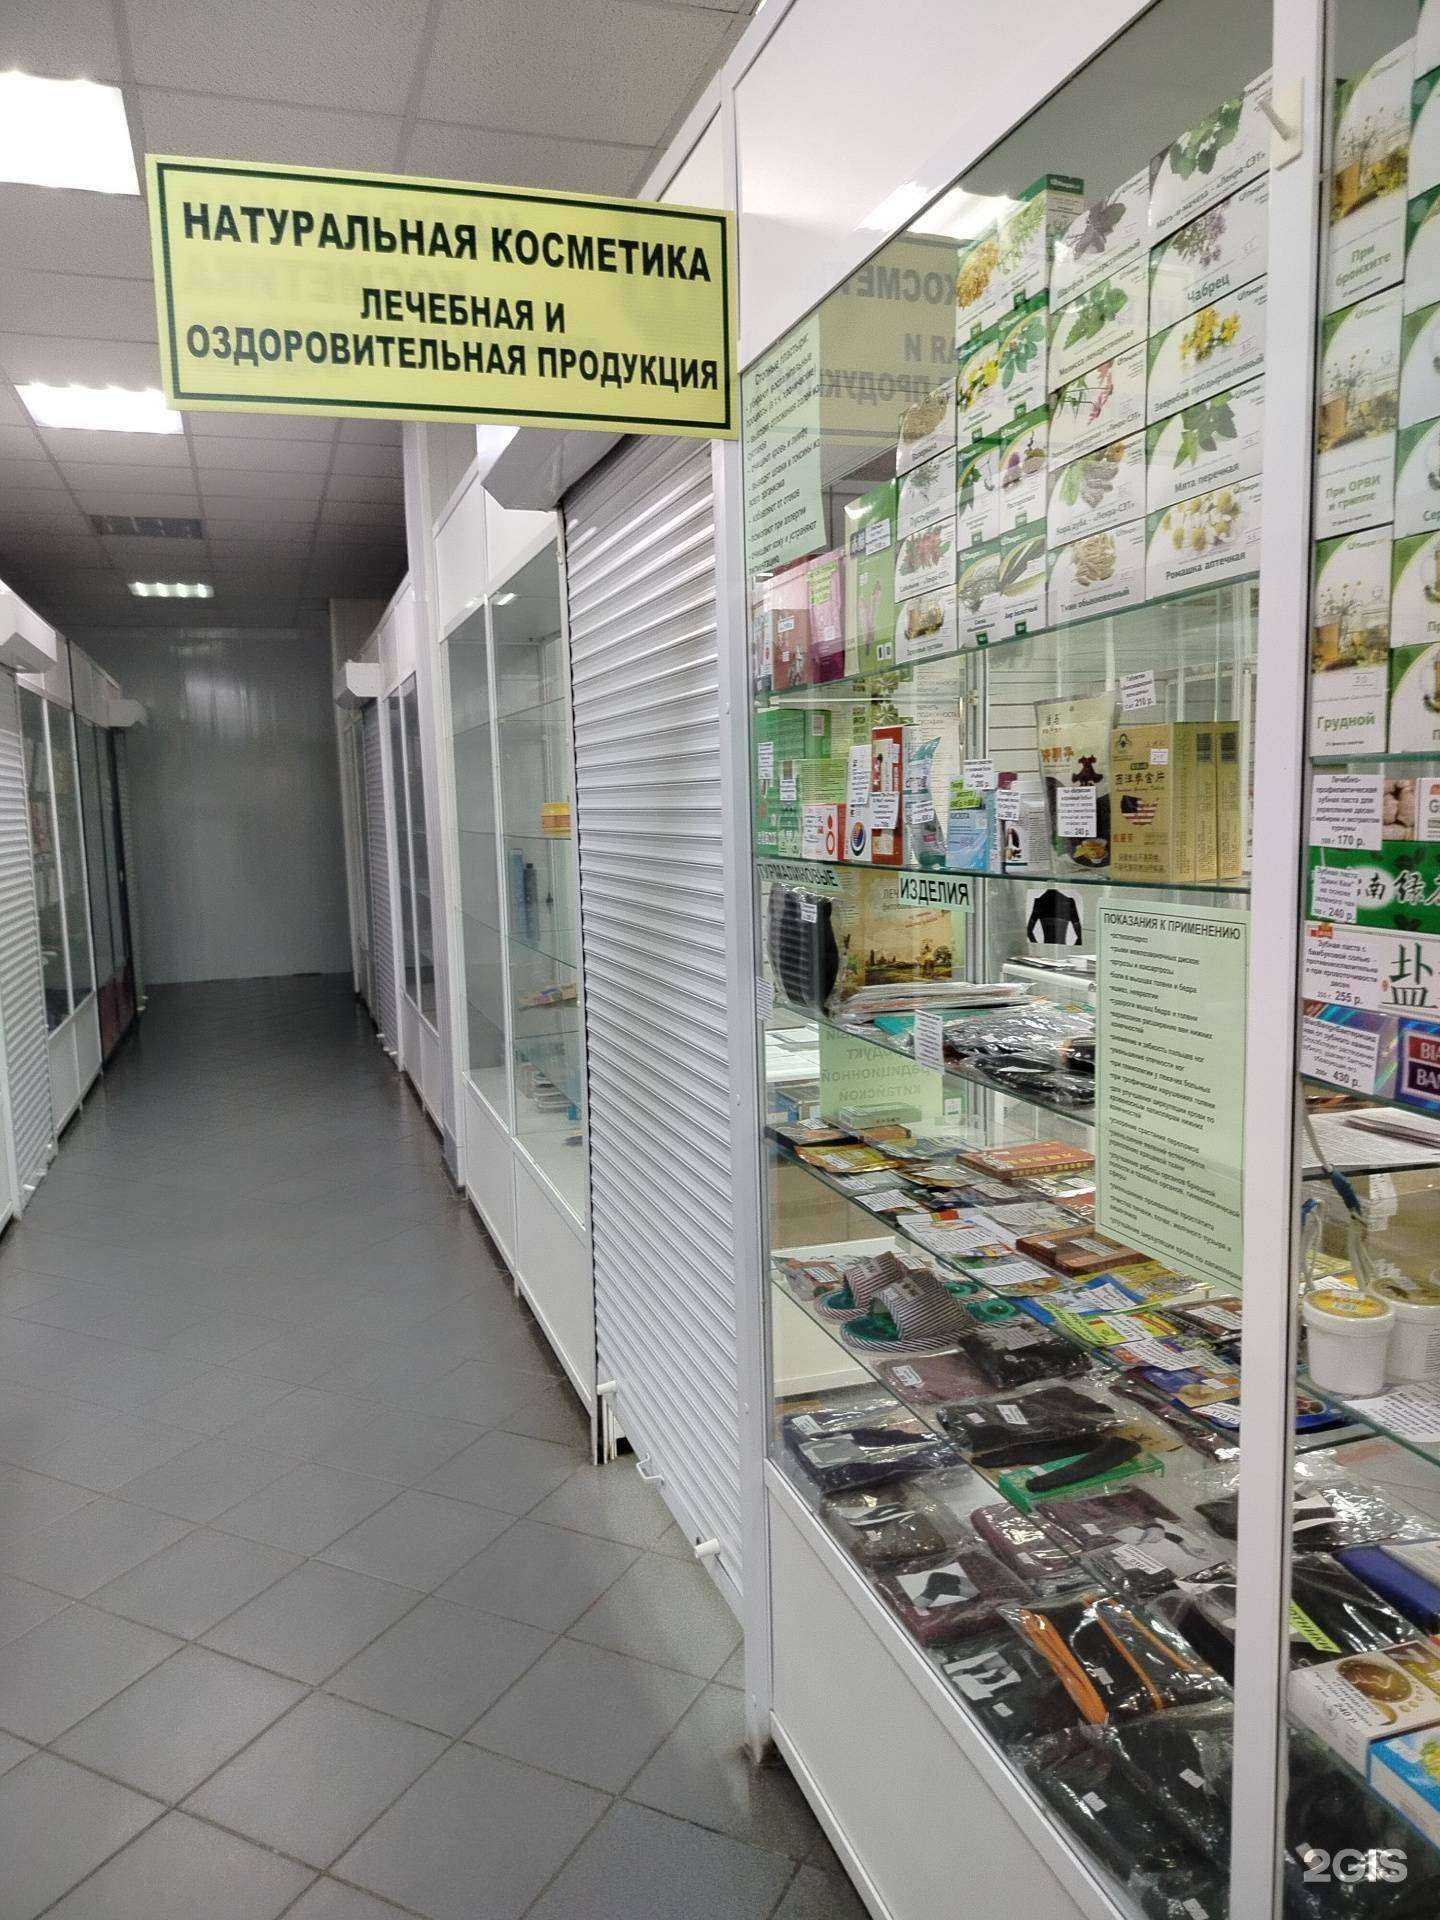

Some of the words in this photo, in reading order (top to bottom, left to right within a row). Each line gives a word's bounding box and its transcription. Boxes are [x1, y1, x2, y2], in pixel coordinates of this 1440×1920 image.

[182, 201, 478, 260] НАТУРАЛЬНАЯ
[492, 227, 710, 282] КОСМЕТИКА
[1351, 244, 1375, 264] При
[1187, 270, 1229, 307] Чабрец
[360, 288, 533, 333] ЛЕЧЕБНАЯ
[546, 302, 565, 333] И
[187, 324, 526, 376] ОЗДОРОВИТЕЛЬНАЯ
[538, 347, 718, 393] ПРОДУКЦИЯ
[1174, 477, 1195, 493] Мята
[1198, 462, 1238, 485] перечная
[1325, 485, 1345, 499] При
[1349, 473, 1381, 492] ОРВИ
[1166, 562, 1201, 580] Ромашка
[1205, 551, 1245, 569] аптечная
[1317, 712, 1375, 733] Грудной
[1337, 834, 1353, 845] 170
[900, 877, 970, 906] ИЗДЕЛИЯ
[1103, 912, 1157, 929] ПОКАЗАНИЯ
[1160, 919, 1166, 930] К
[1168, 920, 1240, 940] ПРИМЕНЕНИЮ
